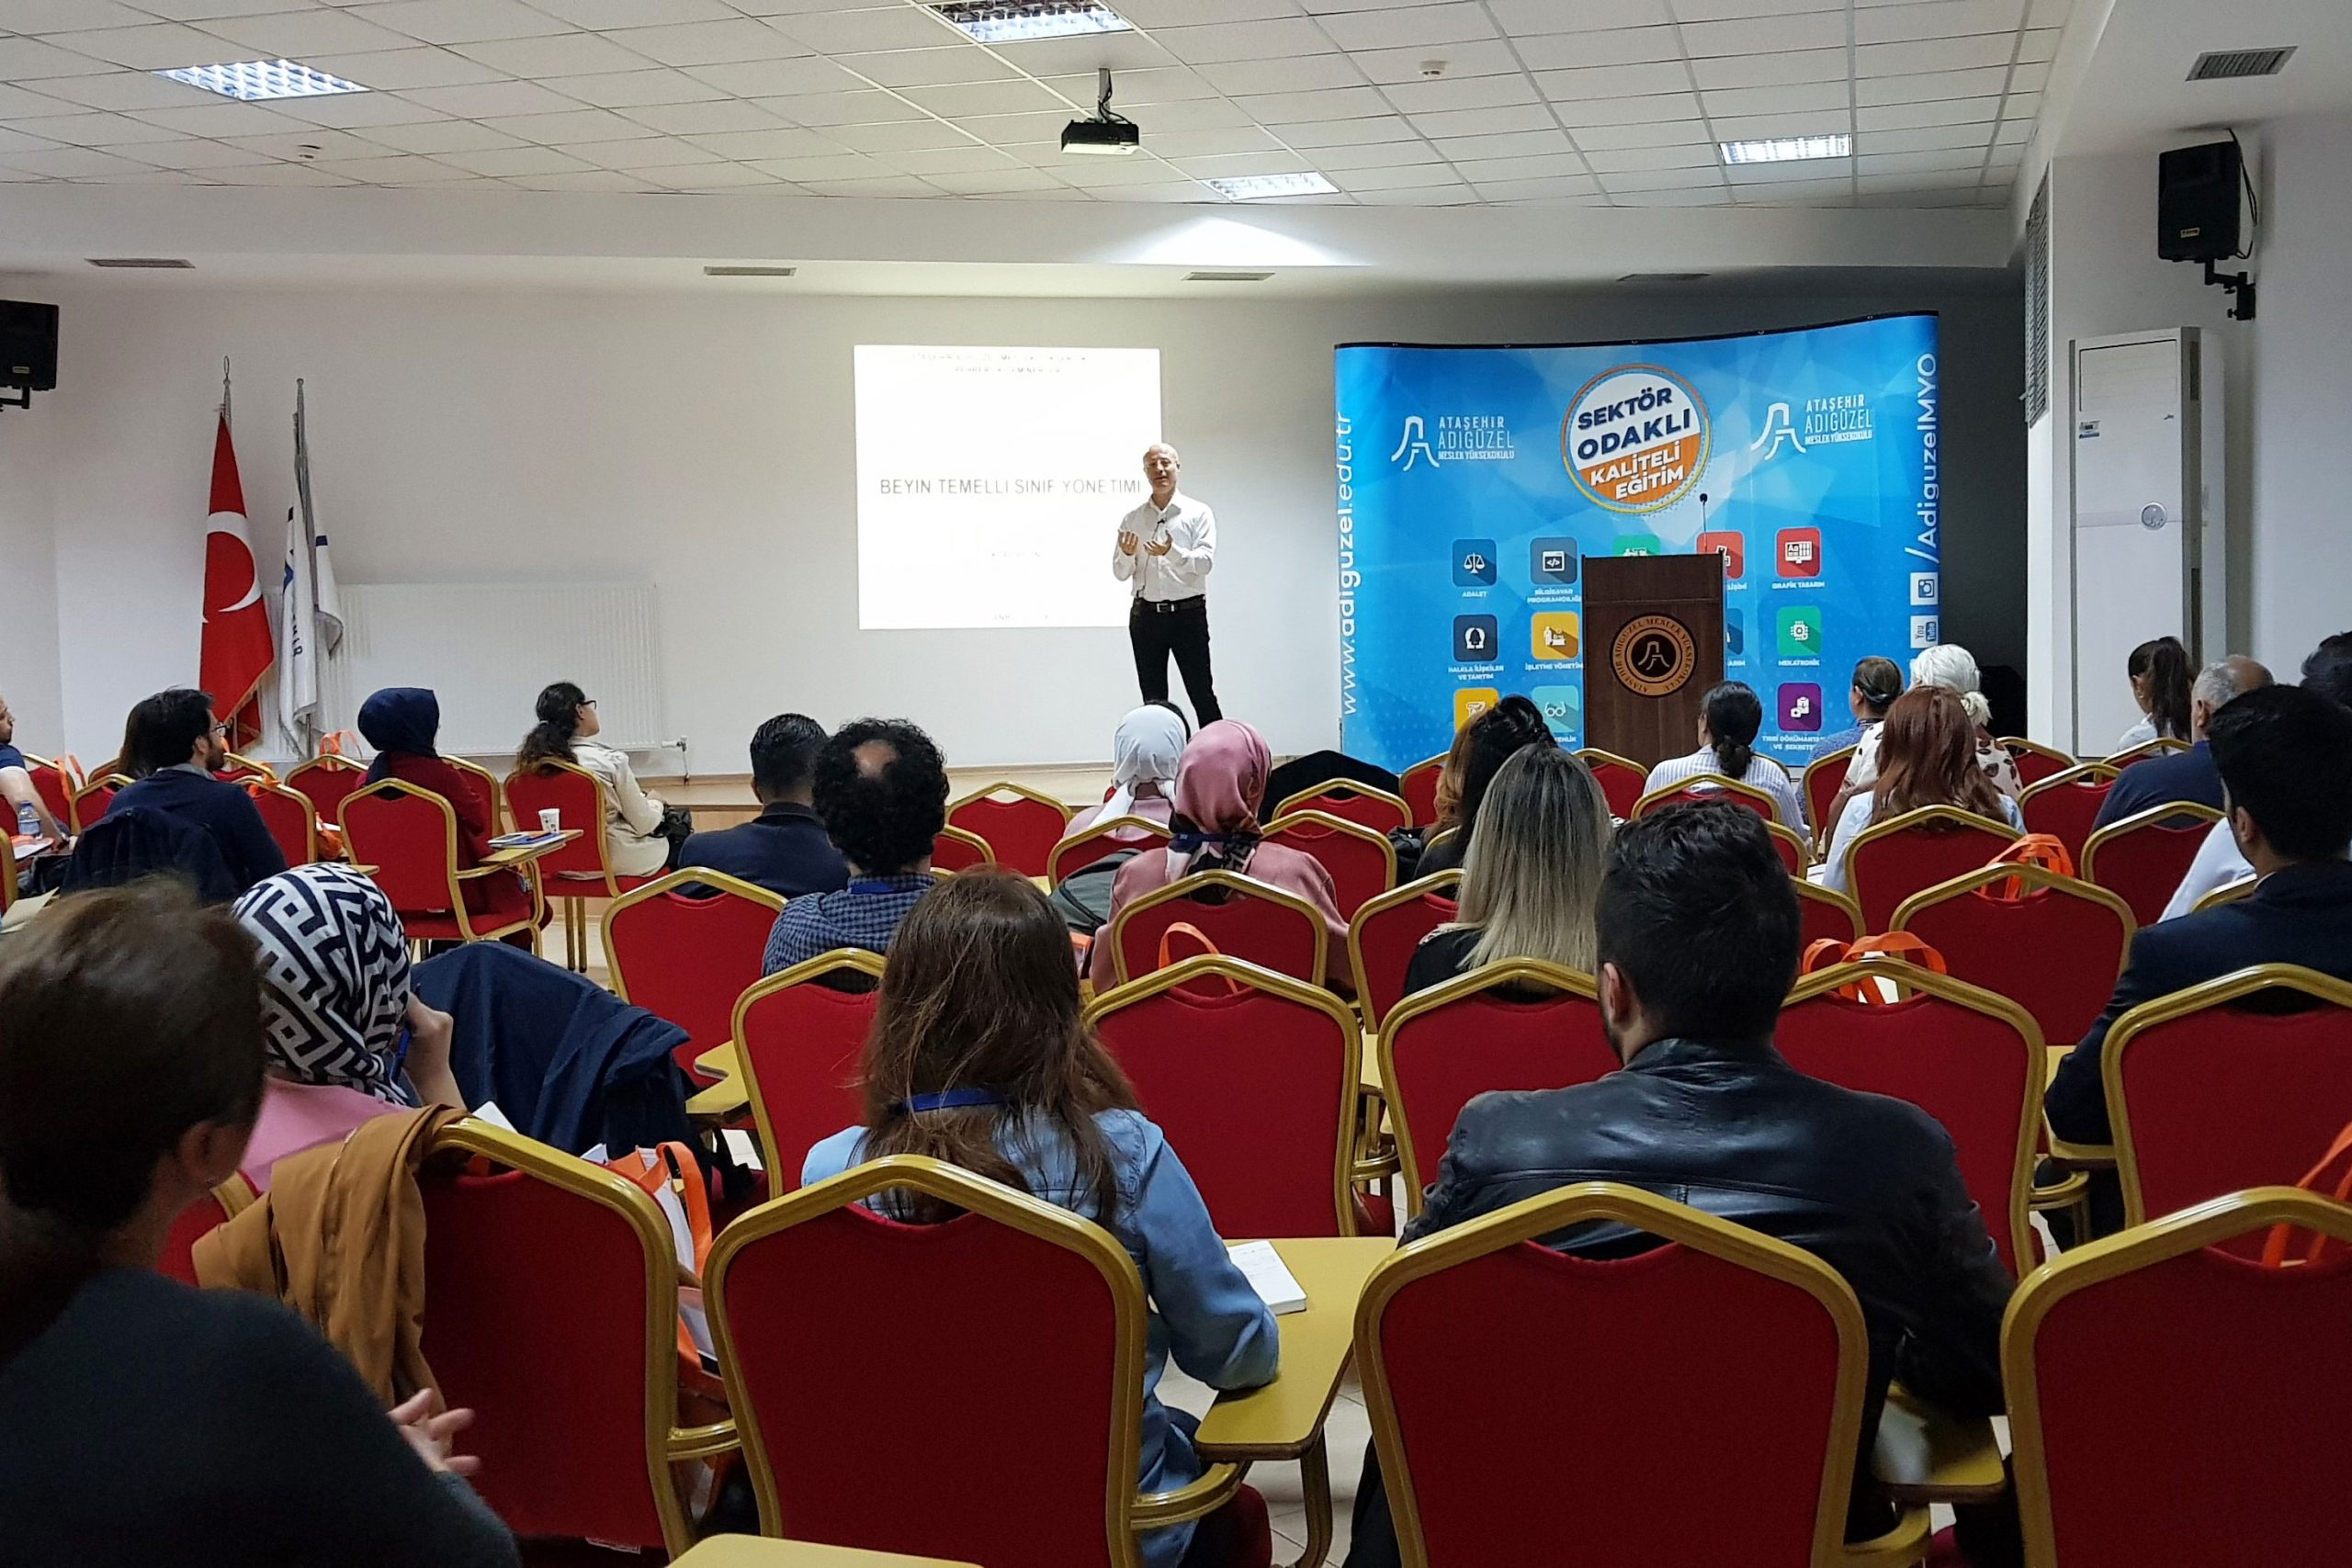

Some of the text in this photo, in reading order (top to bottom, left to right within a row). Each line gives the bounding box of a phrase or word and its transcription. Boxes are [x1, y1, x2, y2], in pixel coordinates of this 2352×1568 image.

[1577, 387, 1672, 430] SEKTÖR
[1804, 409, 1872, 434] ADIGÜZEL
[1438, 428, 1514, 449] ADIGÜZEL
[1577, 408, 1690, 460] ODAKLI
[1438, 450, 1464, 460] MESLEK
[1590, 440, 1681, 487] KALİTELİ
[1904, 353, 1939, 564] /AdiguzelMYO
[1014, 479, 1055, 495] SINIF
[1615, 465, 1684, 500] EĞİTİM
[1336, 412, 1362, 716] www.adiguzel.edu.tr
[1554, 661, 1583, 670] YÖNETİM
